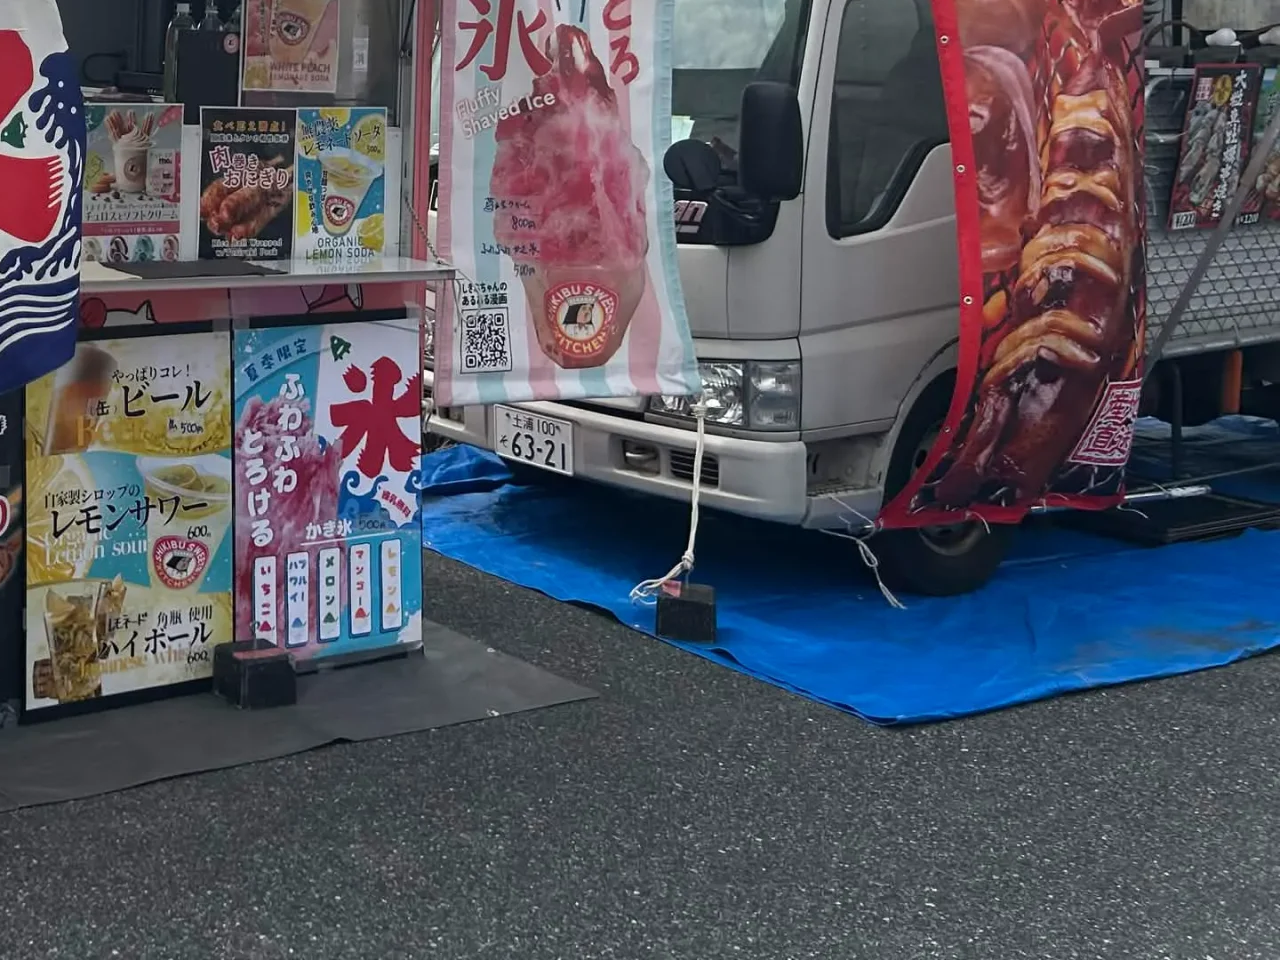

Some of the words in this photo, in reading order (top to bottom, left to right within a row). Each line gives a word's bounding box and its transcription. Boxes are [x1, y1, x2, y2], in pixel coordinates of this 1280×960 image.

[455, 86, 502, 121] Fluffy
[462, 101, 521, 139] Shaved
[526, 90, 557, 112] Ice
[209, 145, 259, 173] 肉巻き
[223, 167, 290, 189] おにぎり
[305, 248, 346, 260] LEMON
[347, 246, 375, 259] SODA
[317, 236, 365, 248] ORGANIC
[112, 363, 191, 383] やっぱりコレ!
[244, 337, 308, 383] 夏季限定
[122, 379, 213, 418] ビール
[329, 355, 421, 480] 氷
[272, 373, 307, 494] ふわふわ
[511, 413, 534, 431] 土浦
[536, 419, 557, 437] 100
[510, 431, 567, 471] 63-21
[243, 427, 275, 548] とろける
[52, 495, 209, 539] レモンサワー
[305, 517, 353, 542] かき氷
[325, 556, 336, 606] メロン
[355, 549, 365, 608] マンゴー
[387, 545, 398, 597] レモン
[96, 622, 214, 660] ハイボール
